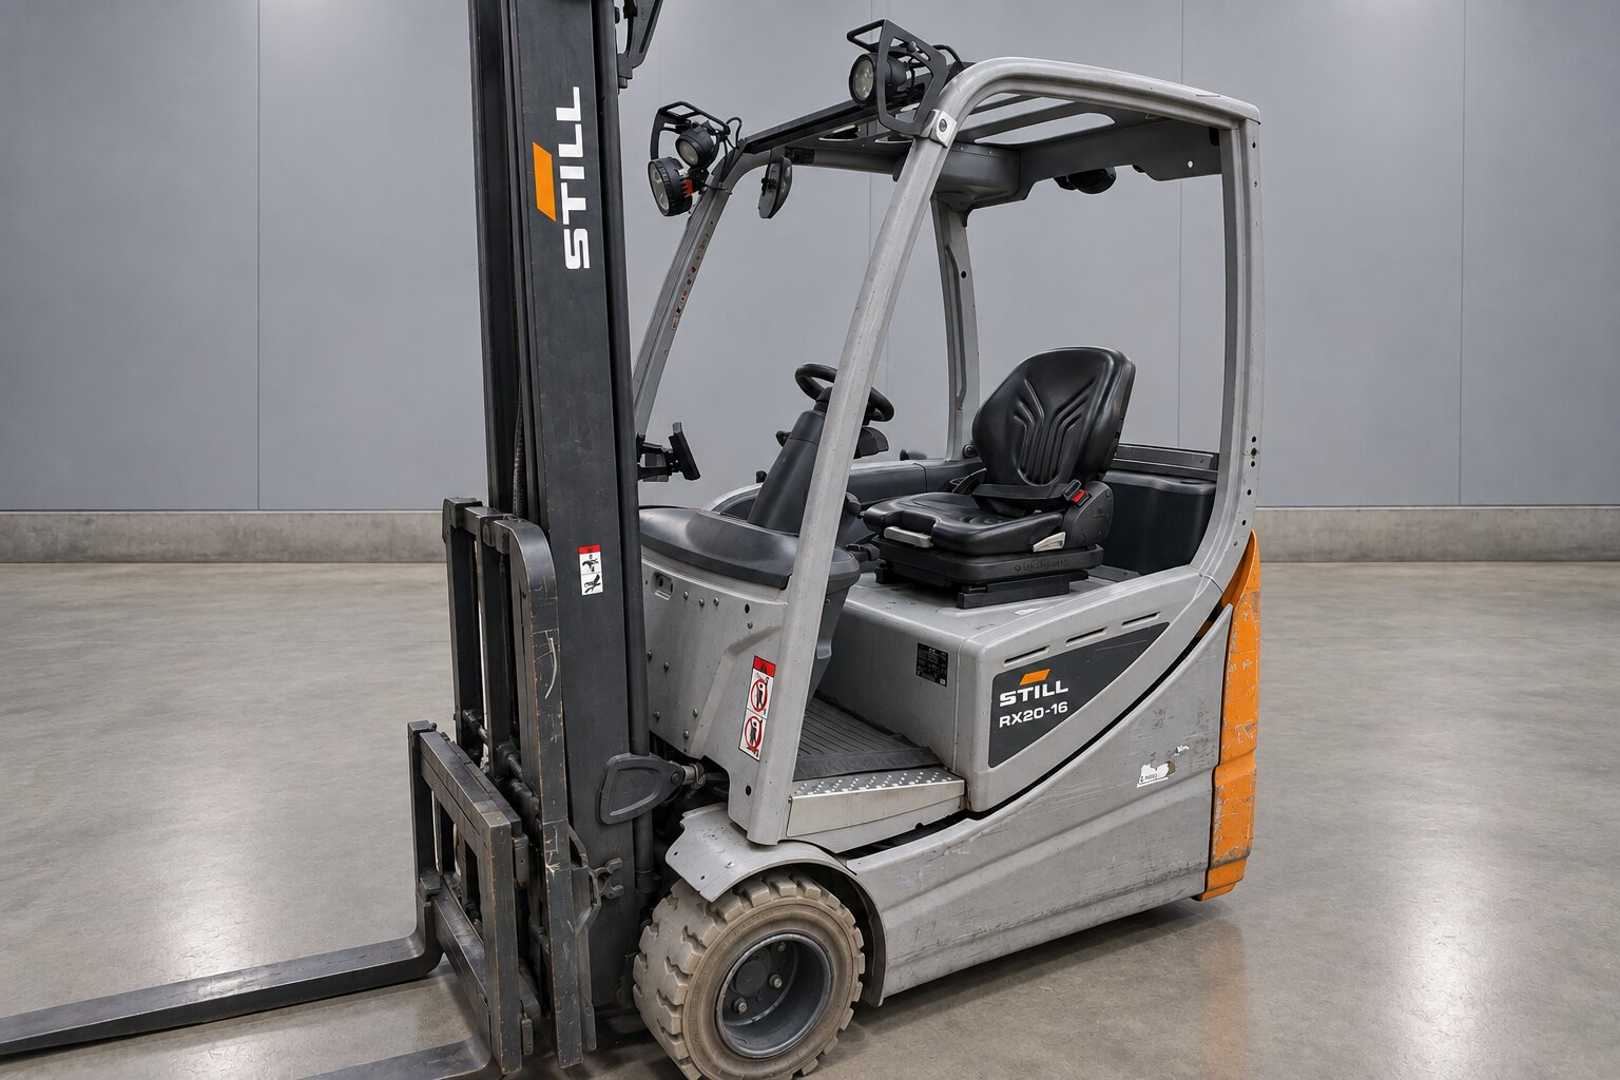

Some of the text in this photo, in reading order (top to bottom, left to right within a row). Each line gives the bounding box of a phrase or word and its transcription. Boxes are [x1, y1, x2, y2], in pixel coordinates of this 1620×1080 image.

[555, 86, 591, 270] STILL
[999, 680, 1069, 707] STILL
[999, 701, 1068, 729] RX20-16
